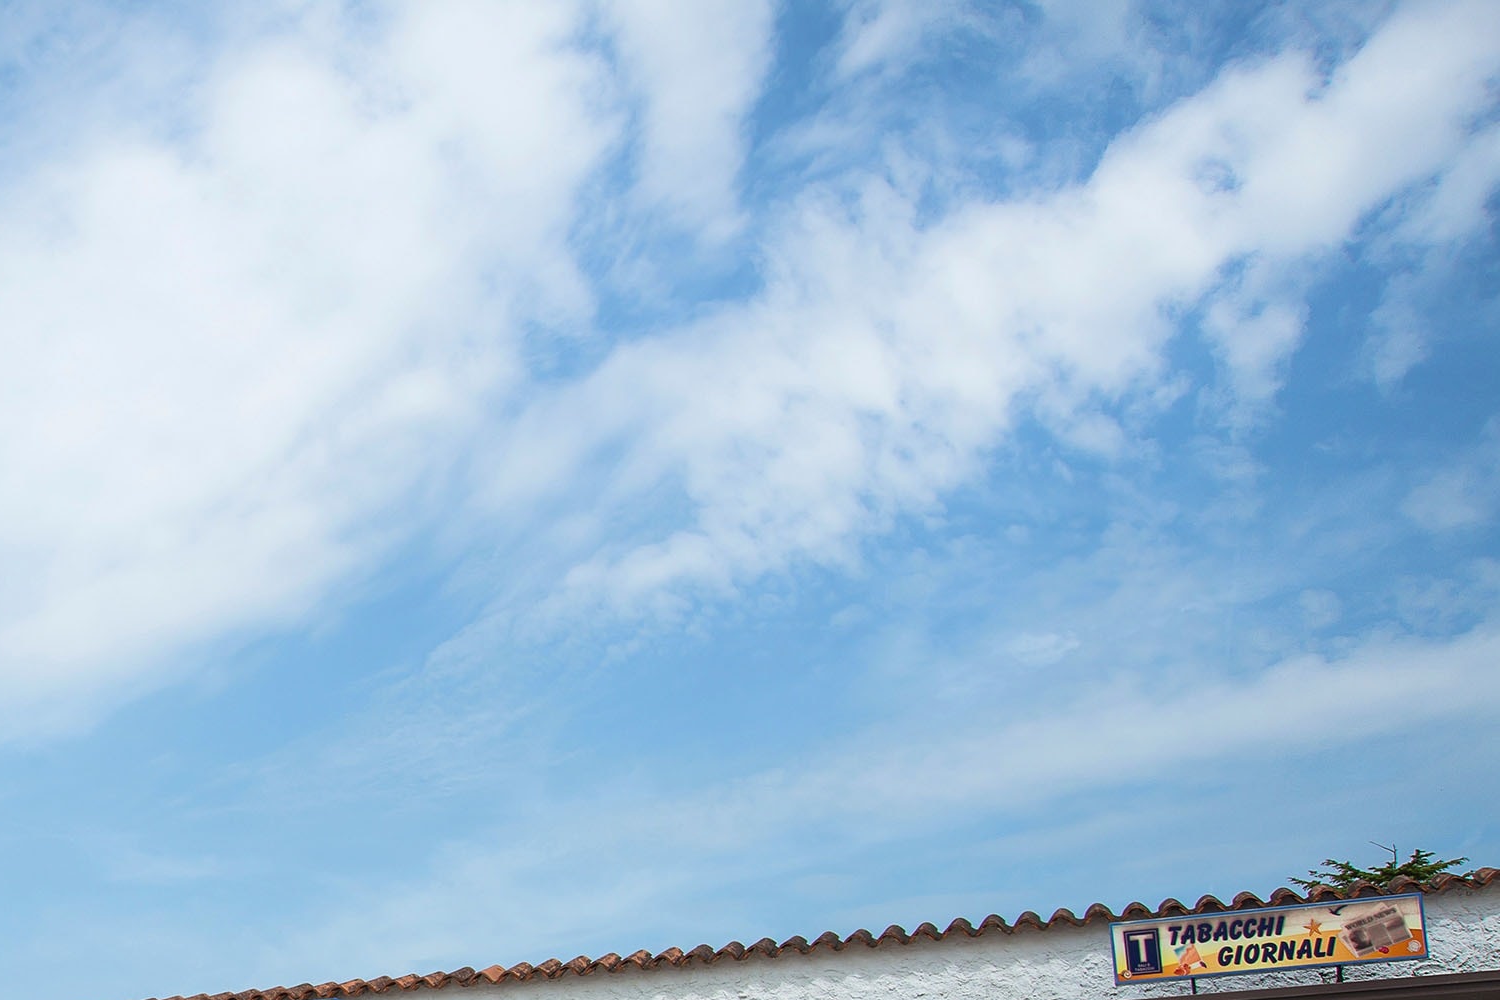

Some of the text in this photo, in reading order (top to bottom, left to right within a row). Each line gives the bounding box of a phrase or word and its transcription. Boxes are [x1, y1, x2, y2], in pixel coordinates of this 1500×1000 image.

[1167, 915, 1285, 945] TABACCHI
[1129, 933, 1153, 963] T
[1217, 936, 1337, 967] GIORNALI
